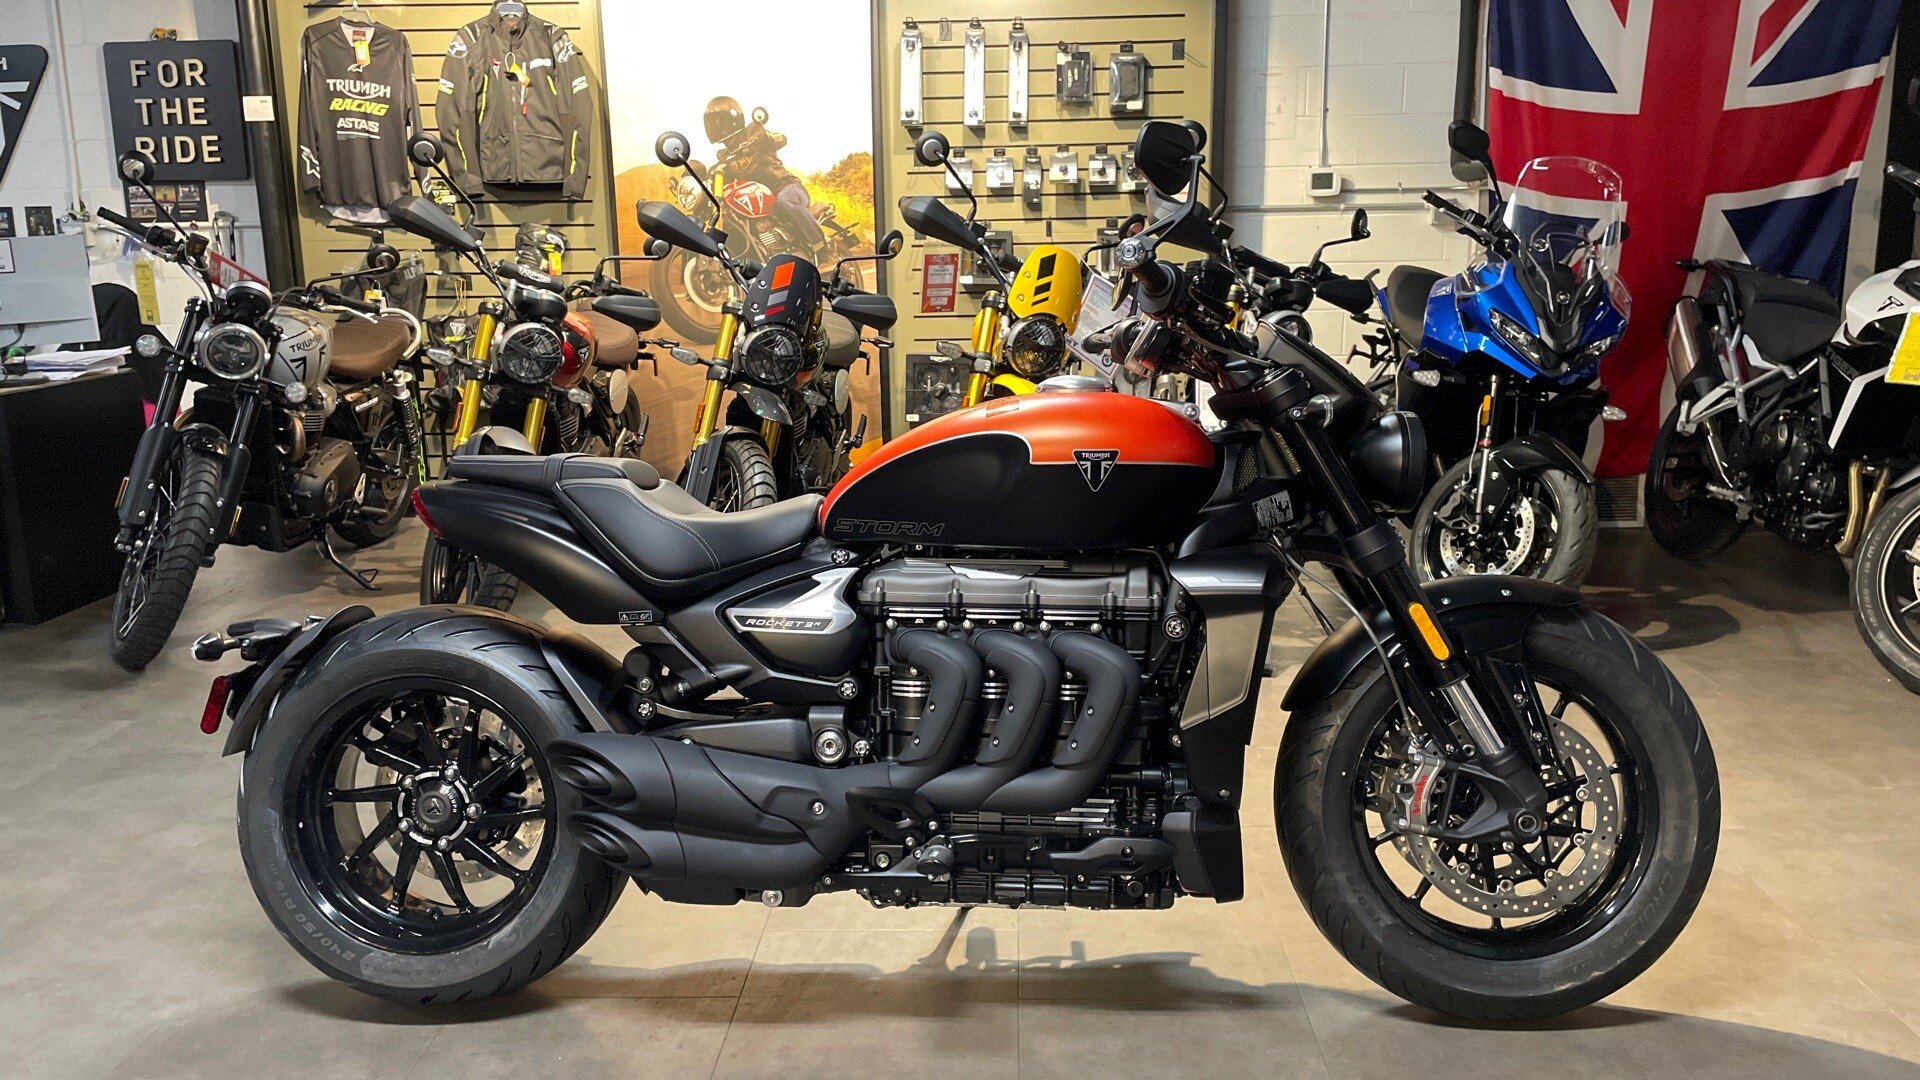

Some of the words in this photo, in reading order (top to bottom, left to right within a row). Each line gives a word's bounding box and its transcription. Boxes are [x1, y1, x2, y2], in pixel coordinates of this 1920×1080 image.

[129, 58, 207, 88] FOR
[326, 79, 391, 99] TRIUMPH
[133, 97, 208, 126] THE
[329, 97, 390, 116] RACNG
[134, 134, 222, 165] RIDE
[289, 334, 323, 353] TRIUM
[1081, 452, 1111, 461] TRIUMPH
[833, 517, 946, 537] STORM
